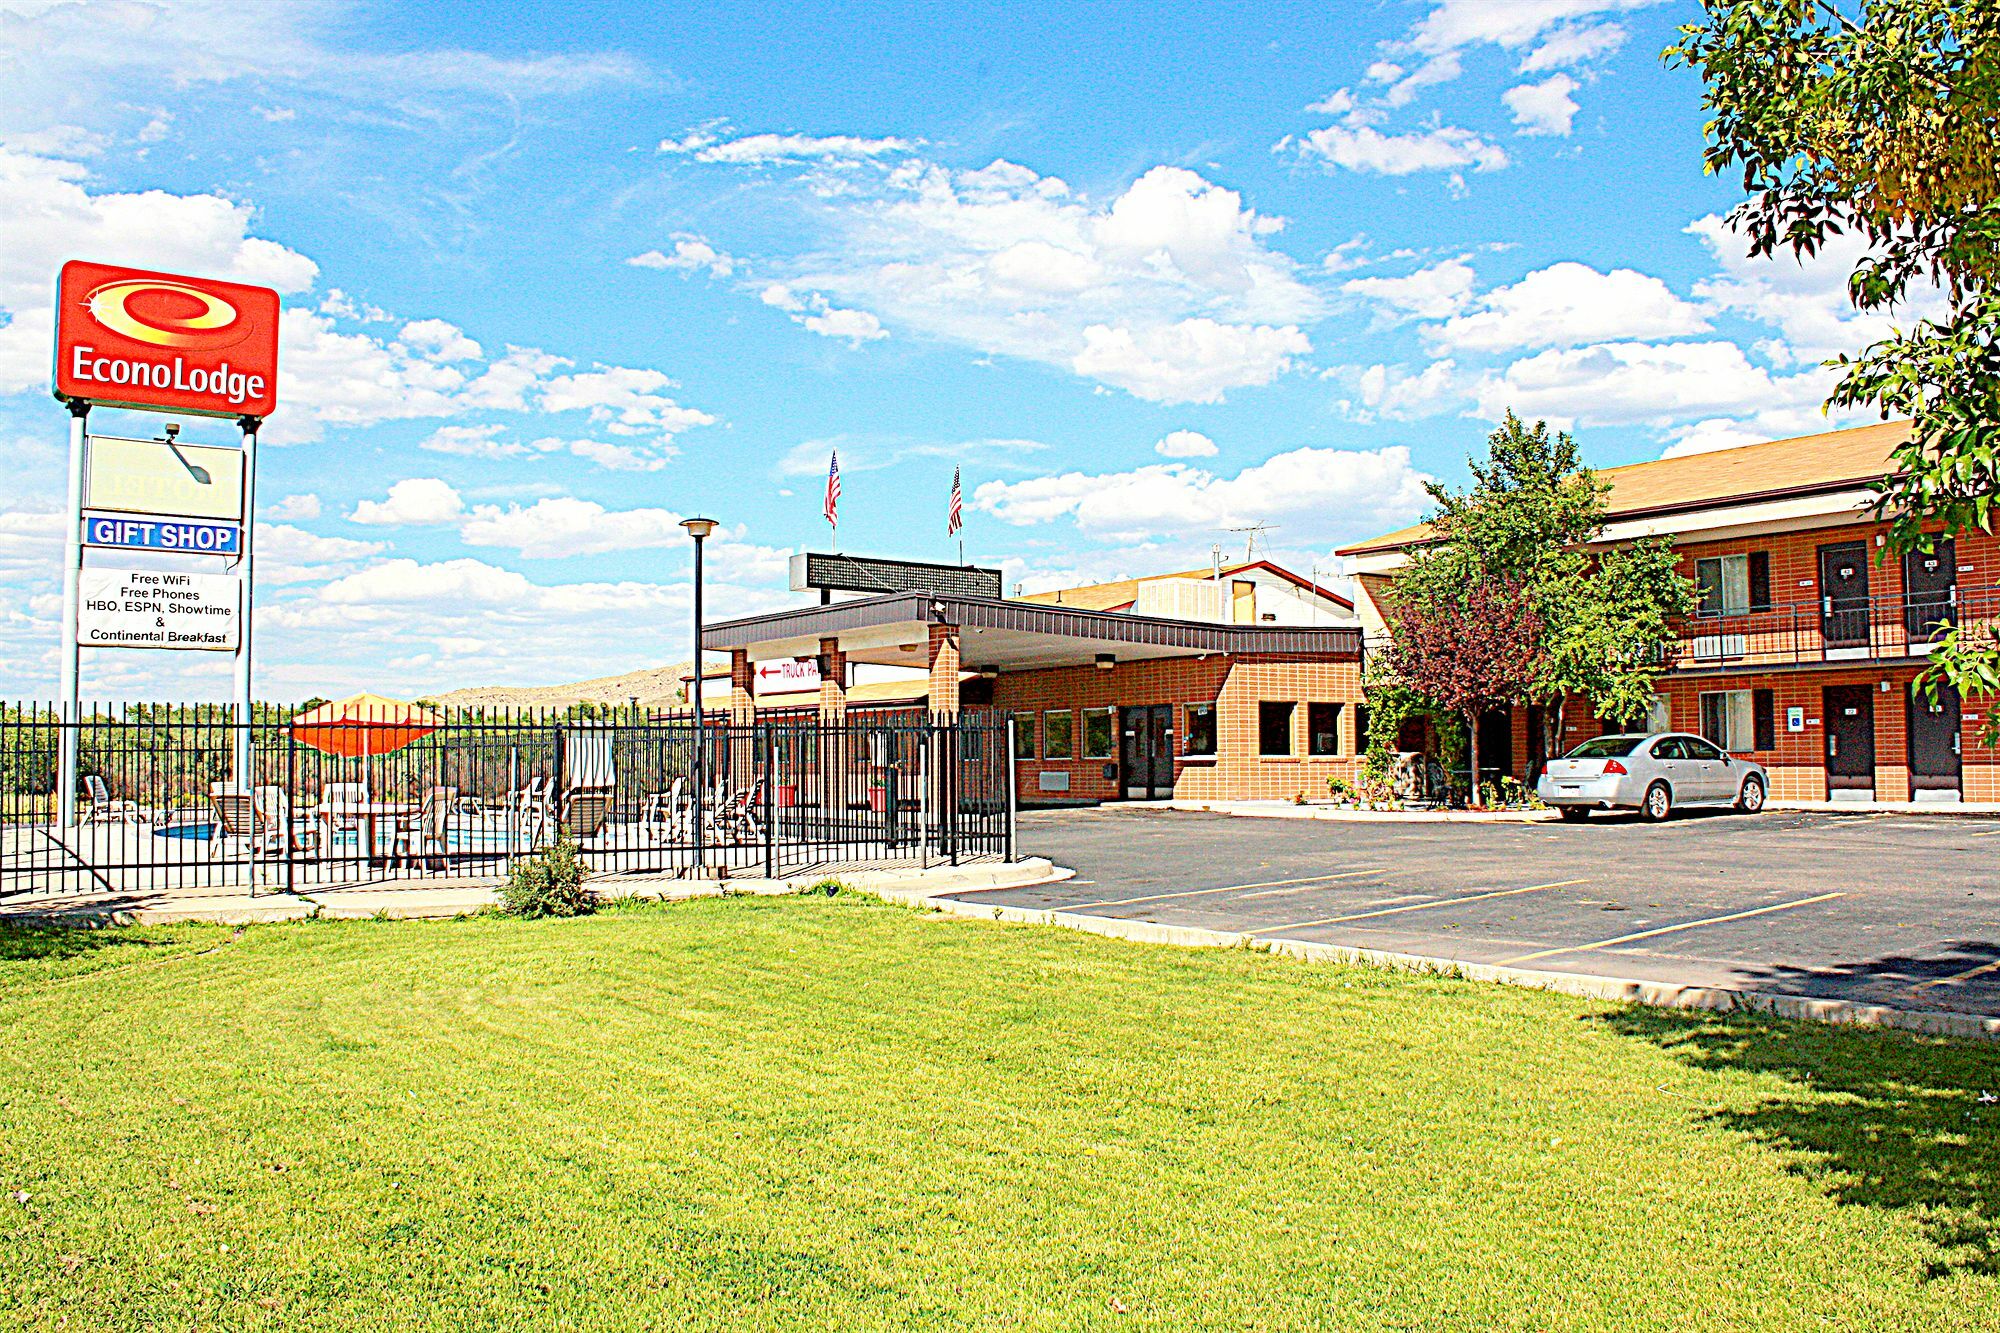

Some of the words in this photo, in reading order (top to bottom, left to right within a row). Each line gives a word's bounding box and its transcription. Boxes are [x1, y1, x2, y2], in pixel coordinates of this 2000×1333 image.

[72, 345, 265, 404] EconoLodge
[94, 520, 156, 544] GIFT
[160, 525, 232, 549] SHOP
[131, 573, 160, 585] Free
[163, 575, 190, 586] WiFi
[120, 586, 149, 598] Free
[152, 588, 200, 600] Phones
[86, 600, 121, 612] HBO,
[125, 601, 165, 613] ESPN,
[168, 602, 231, 615] Showtime
[155, 616, 165, 627] &
[90, 629, 164, 641] Continental
[168, 631, 226, 643] Breakfast
[781, 662, 805, 679] TRUCK
